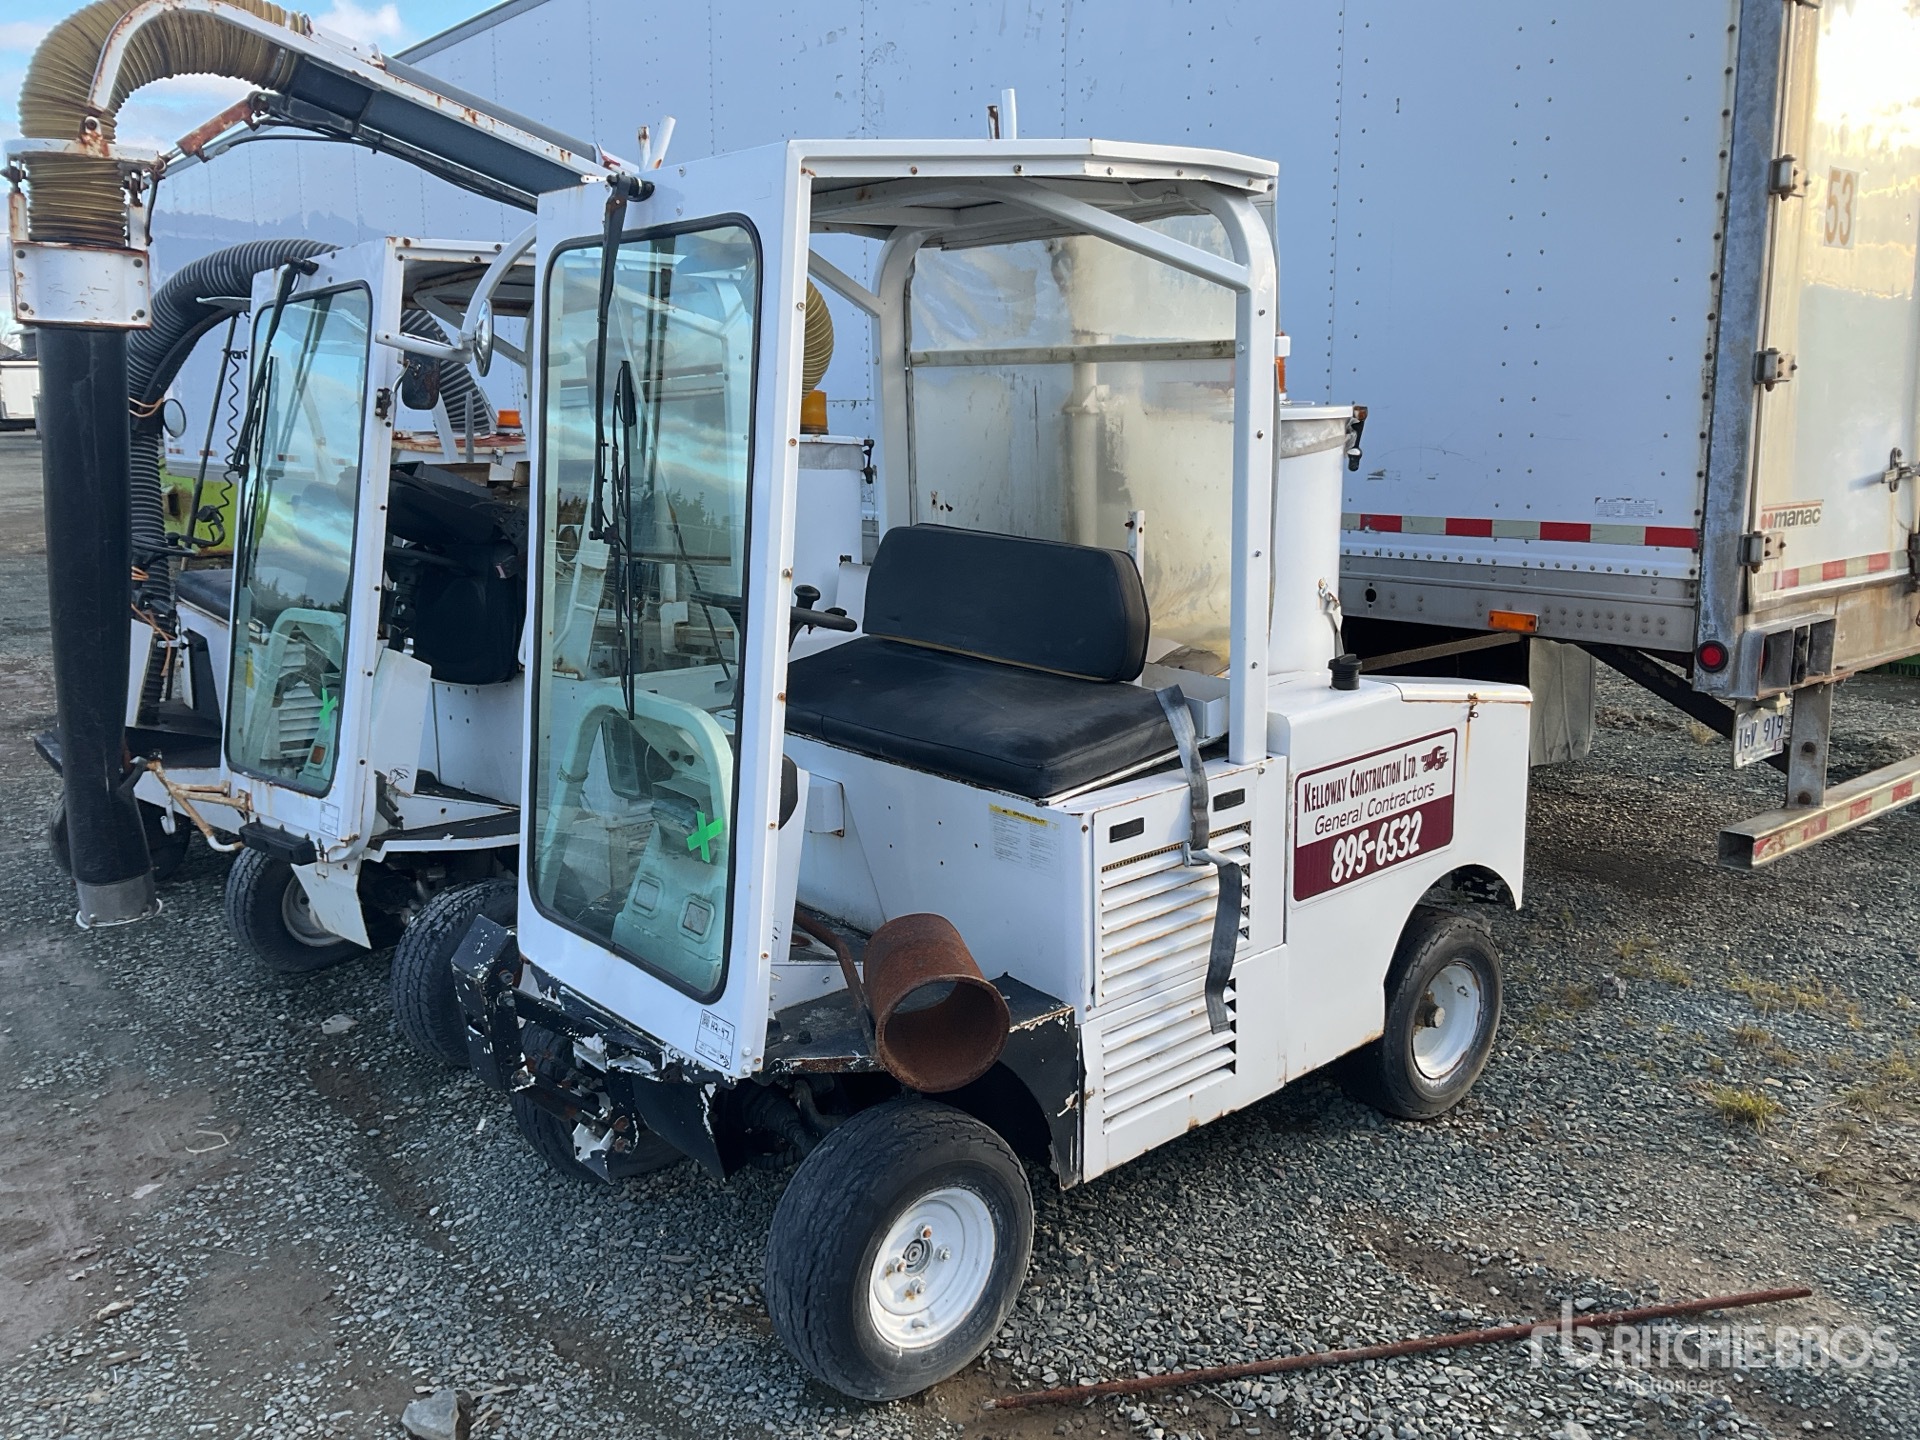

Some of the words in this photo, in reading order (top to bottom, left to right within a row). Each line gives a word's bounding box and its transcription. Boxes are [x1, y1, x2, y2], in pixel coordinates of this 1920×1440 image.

[1825, 170, 1854, 245] 53
[1773, 508, 1822, 528] manac
[1763, 715, 1784, 742] 919
[1303, 776, 1347, 813] KELLOWAY
[1349, 760, 1402, 798] CONSTRUCTION
[1403, 753, 1418, 781] LTD.
[1315, 802, 1364, 835] General
[1367, 782, 1436, 818] Contractors
[1330, 810, 1423, 883] 895-6532
